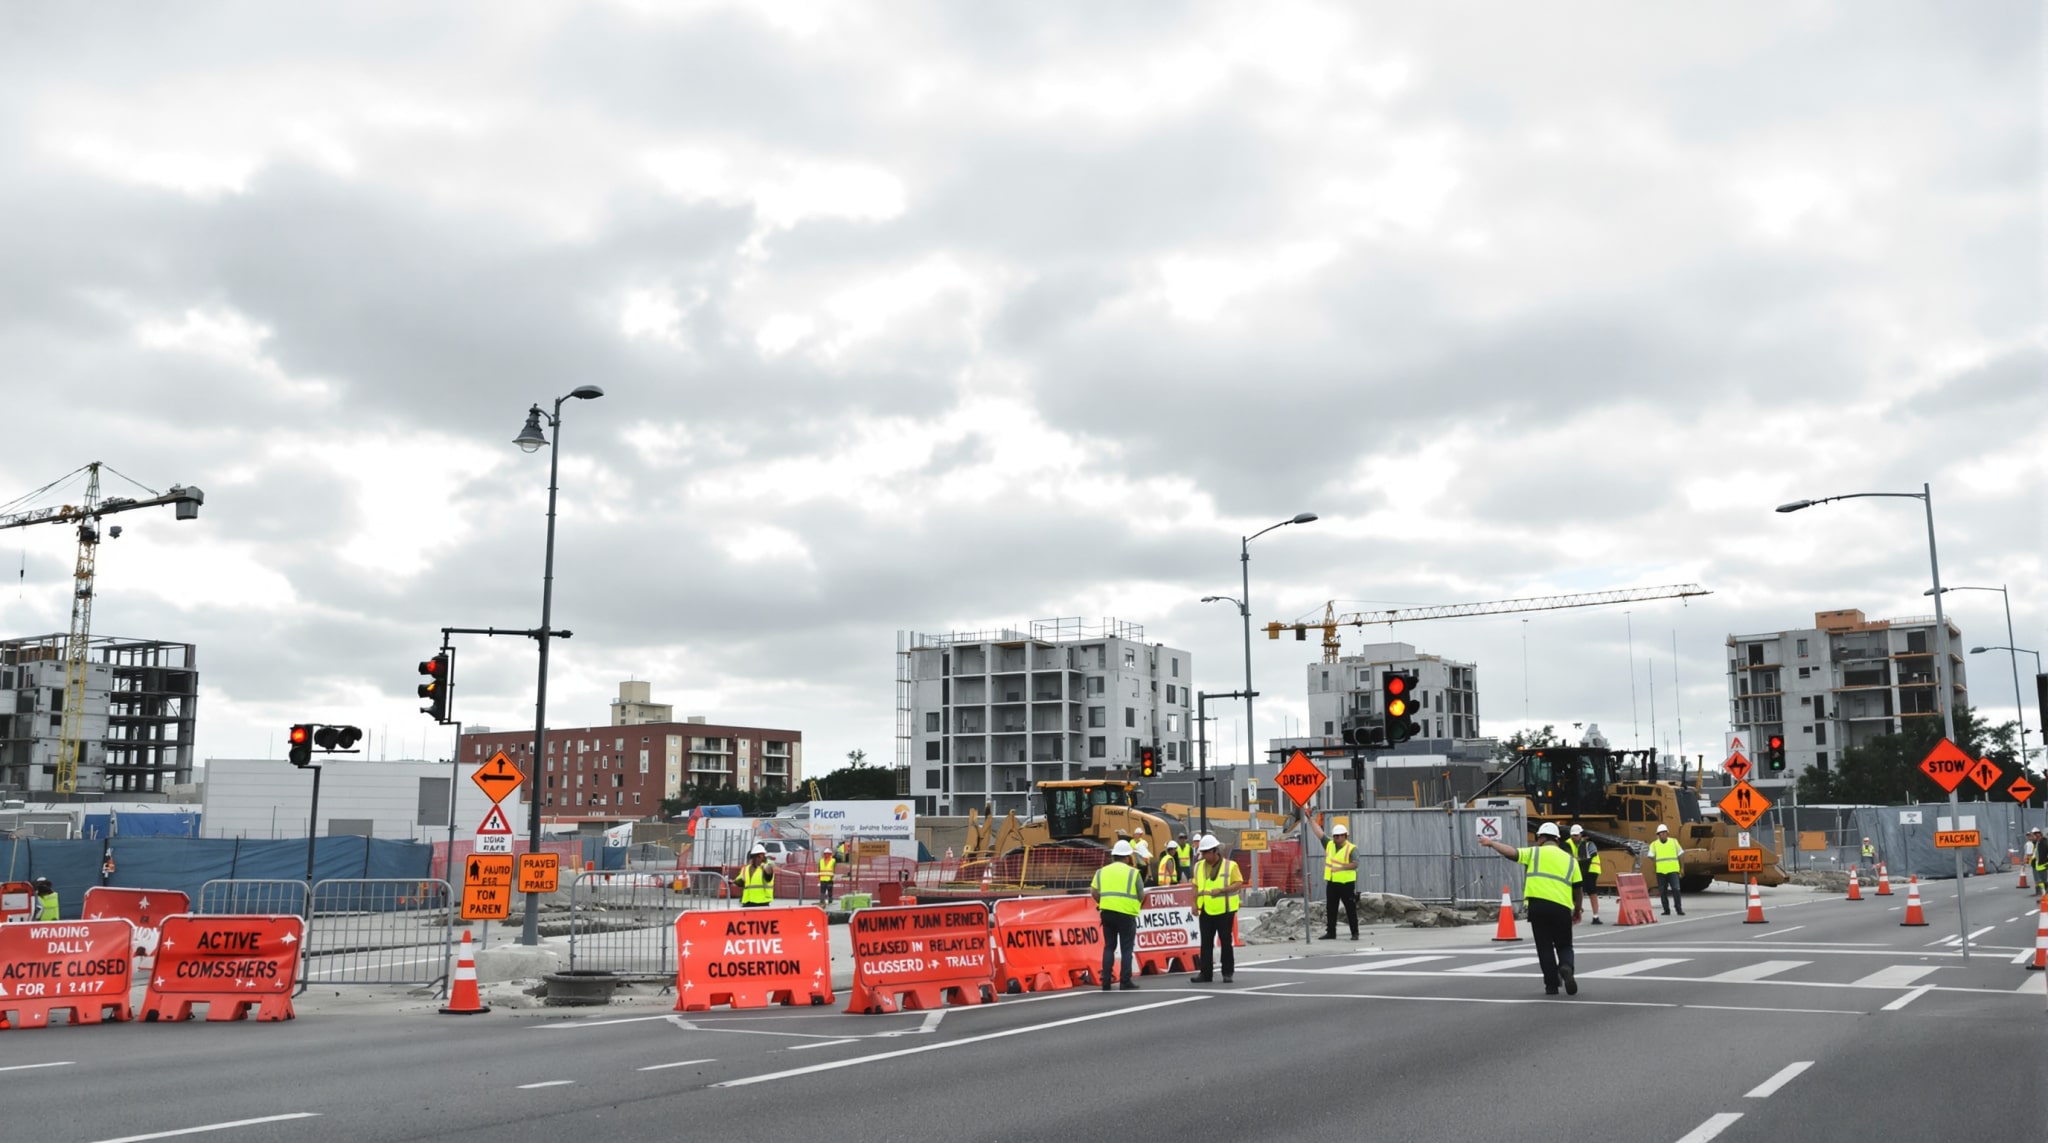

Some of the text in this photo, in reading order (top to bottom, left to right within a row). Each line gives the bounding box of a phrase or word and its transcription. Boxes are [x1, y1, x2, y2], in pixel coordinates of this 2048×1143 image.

[1928, 759, 1966, 773] STOW
[477, 889, 496, 900] TON
[470, 904, 502, 914] PAREN
[30, 926, 90, 939] WRADING
[726, 920, 780, 936] ACTIVE
[857, 915, 908, 933] MUMMY
[47, 940, 94, 954] DALLY
[197, 931, 262, 949] ACTIVE
[723, 938, 784, 956] ACTIVE
[1007, 928, 1055, 949] ACTIVE
[859, 941, 909, 957] CLEASED
[912, 941, 923, 953] IN
[2, 959, 126, 979] ACTIVE CLOSED
[176, 961, 278, 979] COMSSHERS
[708, 960, 800, 978] CLOSERTION
[863, 954, 985, 975] CLOSSERD TRALEY
[16, 983, 45, 996] FOR
